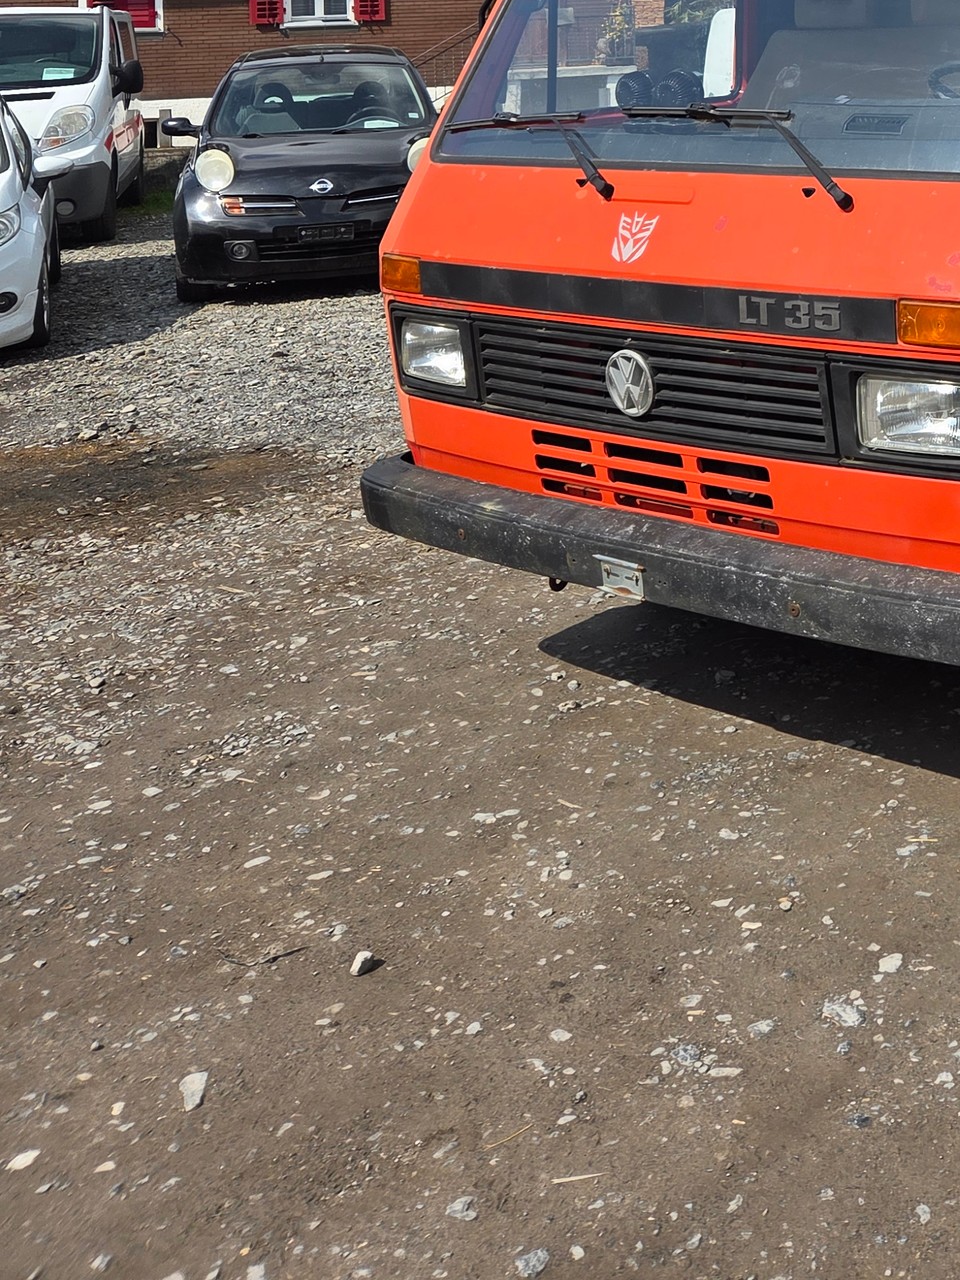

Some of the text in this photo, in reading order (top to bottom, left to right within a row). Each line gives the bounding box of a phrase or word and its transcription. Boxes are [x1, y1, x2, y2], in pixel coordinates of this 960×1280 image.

[738, 295, 841, 331] LT 35
[607, 351, 651, 416] VW
